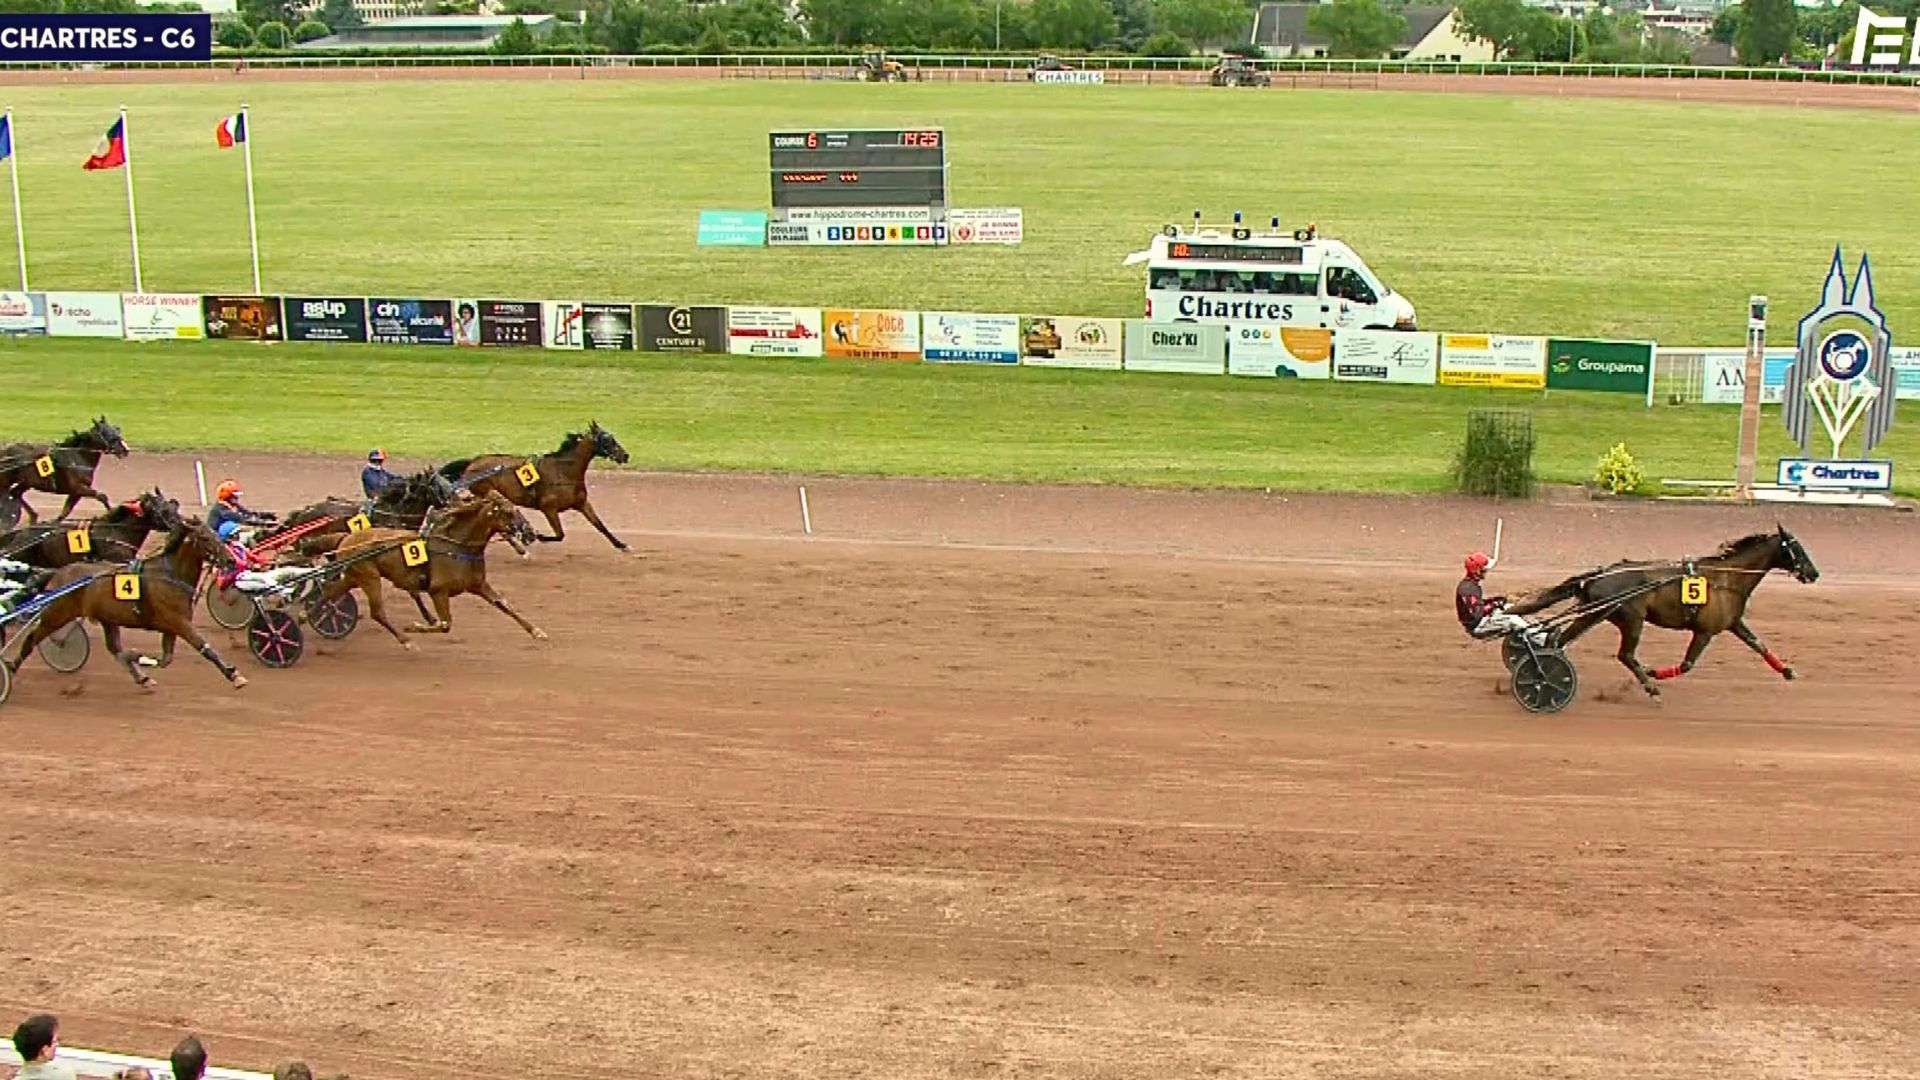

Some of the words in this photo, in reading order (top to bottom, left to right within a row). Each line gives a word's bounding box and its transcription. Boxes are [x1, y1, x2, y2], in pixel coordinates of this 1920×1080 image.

[1037, 73, 1102, 82] CHARTRES
[808, 132, 816, 147] 6
[790, 210, 928, 221] www.hippodrome-chartres.com
[125, 296, 157, 305] HORSE
[160, 297, 198, 306] WINNER
[1179, 295, 1293, 320] Chartres
[676, 313, 690, 327] 21
[656, 337, 695, 346] CENTURY
[1578, 358, 1645, 374] Groupama
[41, 461, 49, 472] 8
[1812, 465, 1880, 480] Chartres
[523, 468, 533, 481] 3
[409, 545, 420, 560] 9
[122, 579, 133, 595] 4
[1688, 583, 1700, 599] 5
